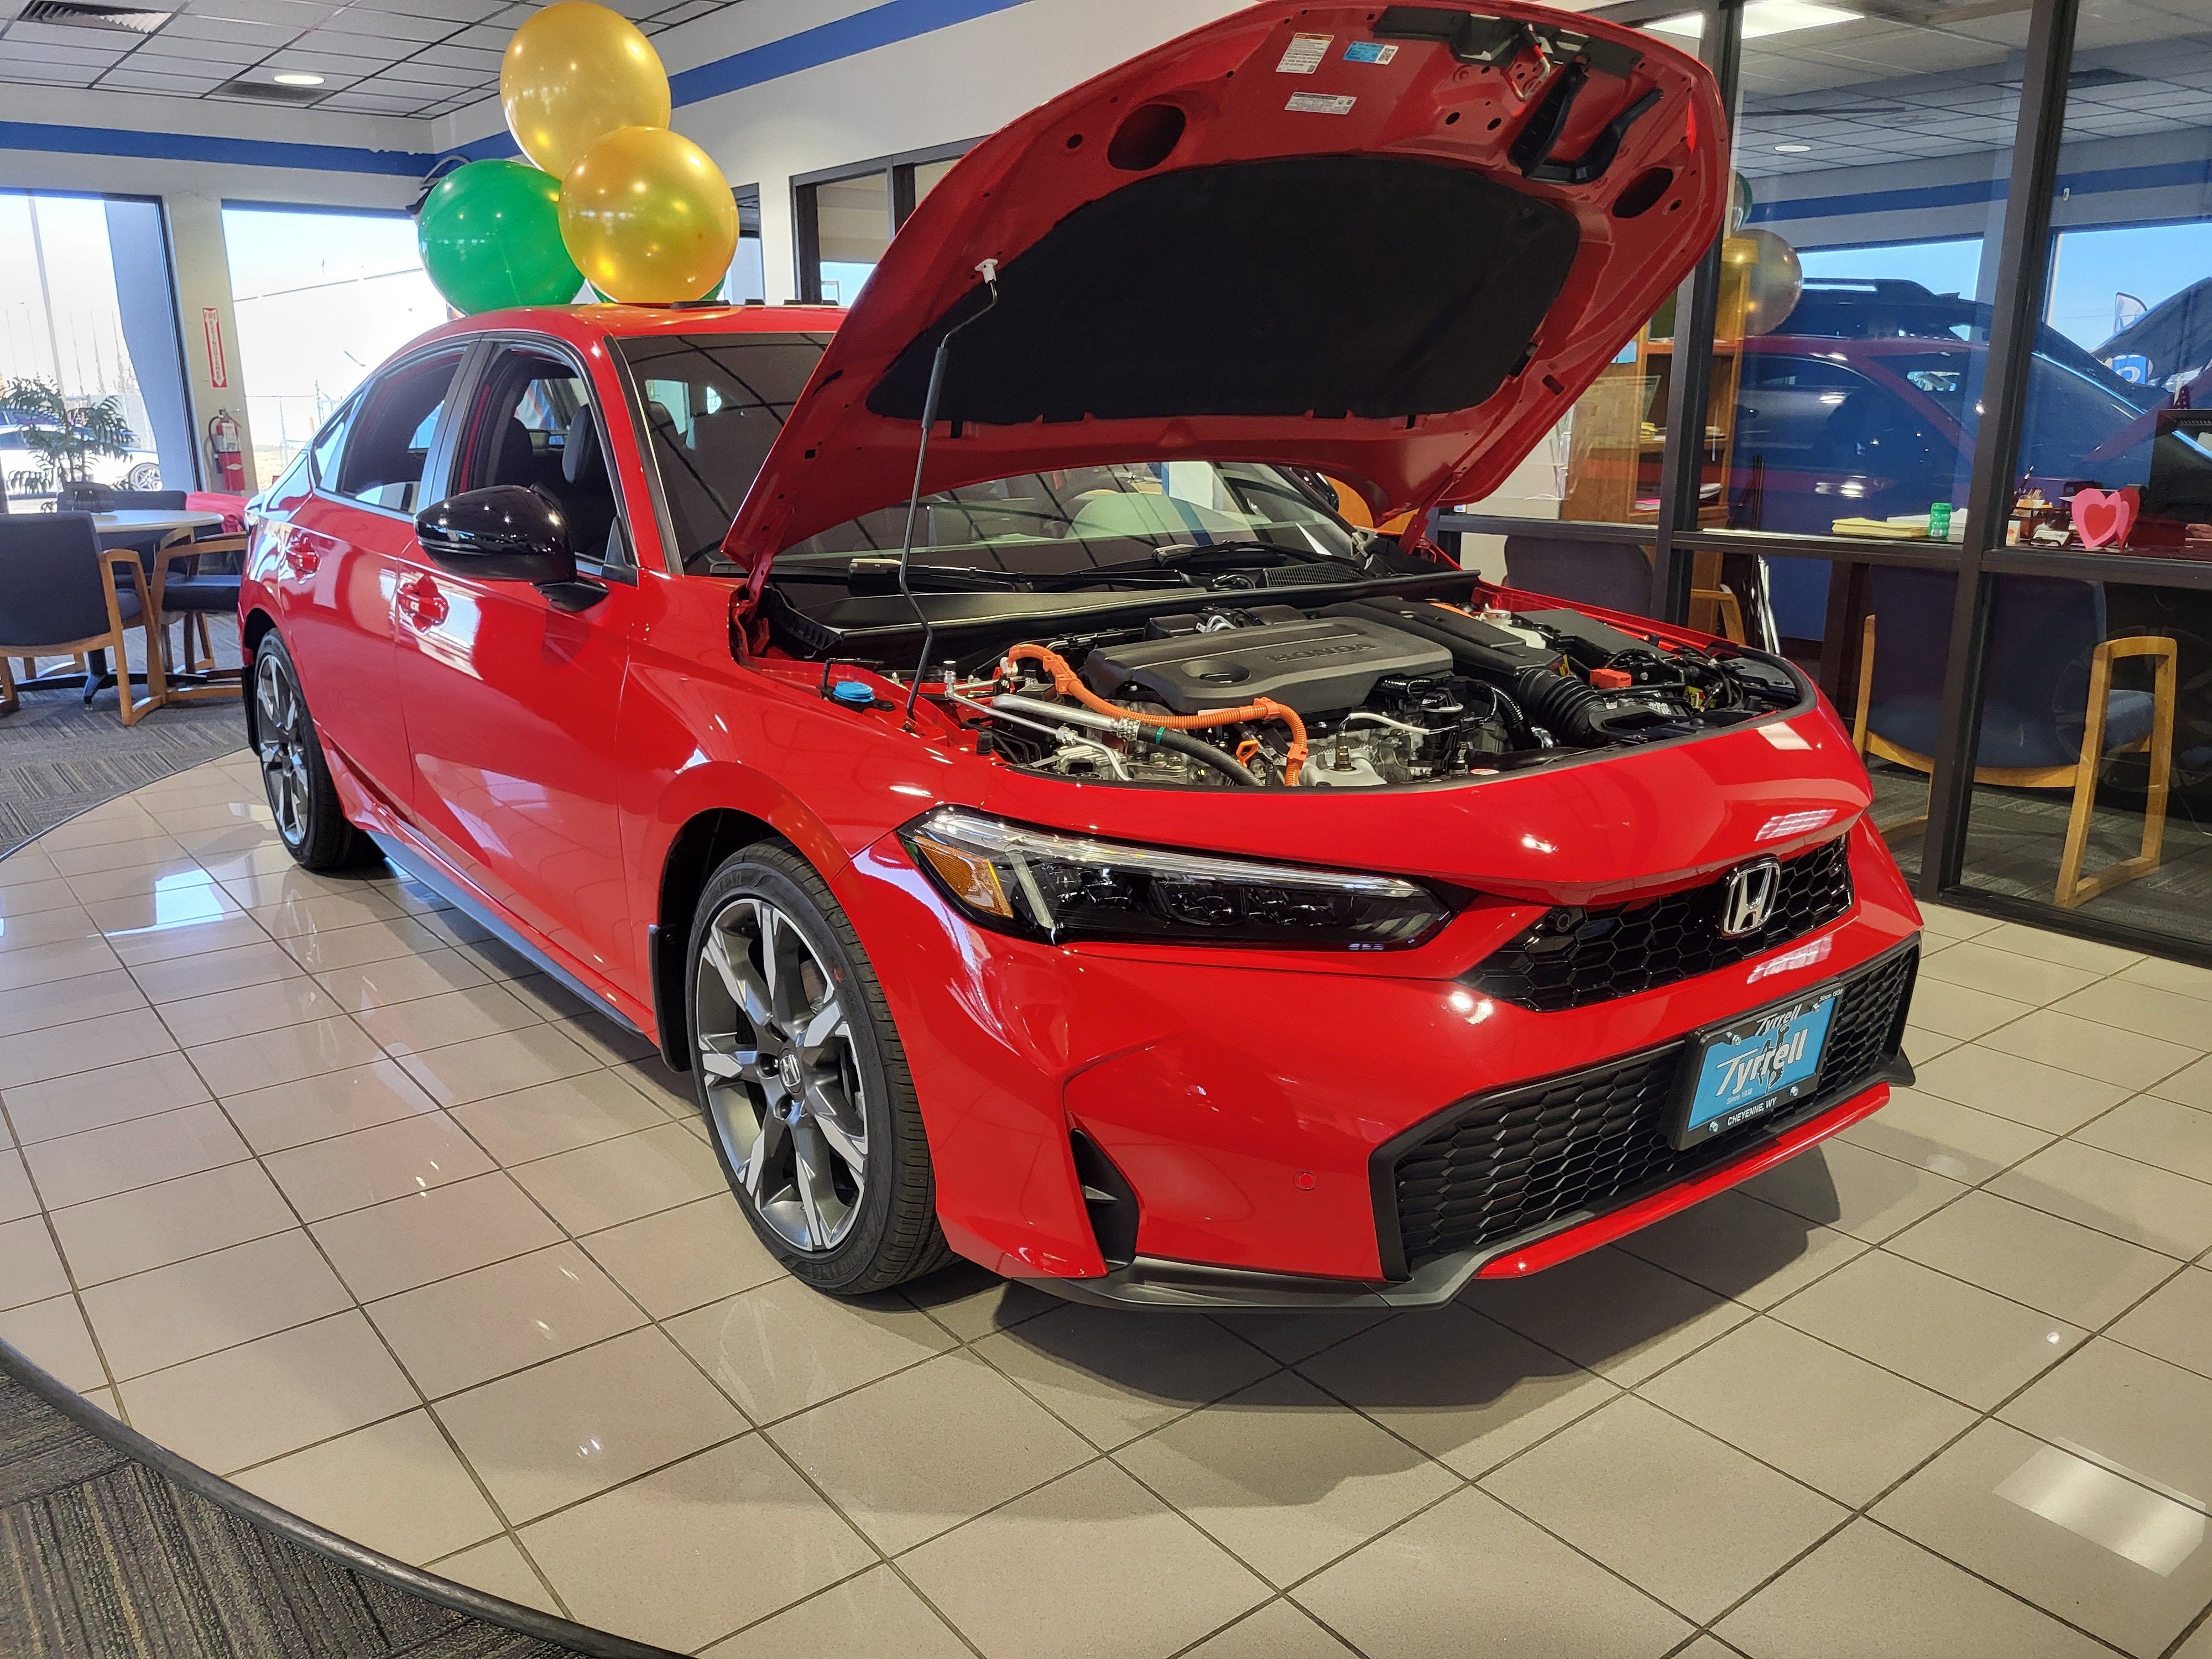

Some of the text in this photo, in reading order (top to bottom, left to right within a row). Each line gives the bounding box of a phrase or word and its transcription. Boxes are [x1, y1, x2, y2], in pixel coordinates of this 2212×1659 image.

[1266, 643, 1381, 663] HONDA
[1755, 1004, 1803, 1036] Tyrrell
[1715, 1027, 1809, 1097] Tyrrell
[1727, 1097, 1777, 1126] CHEYENNE, WY
